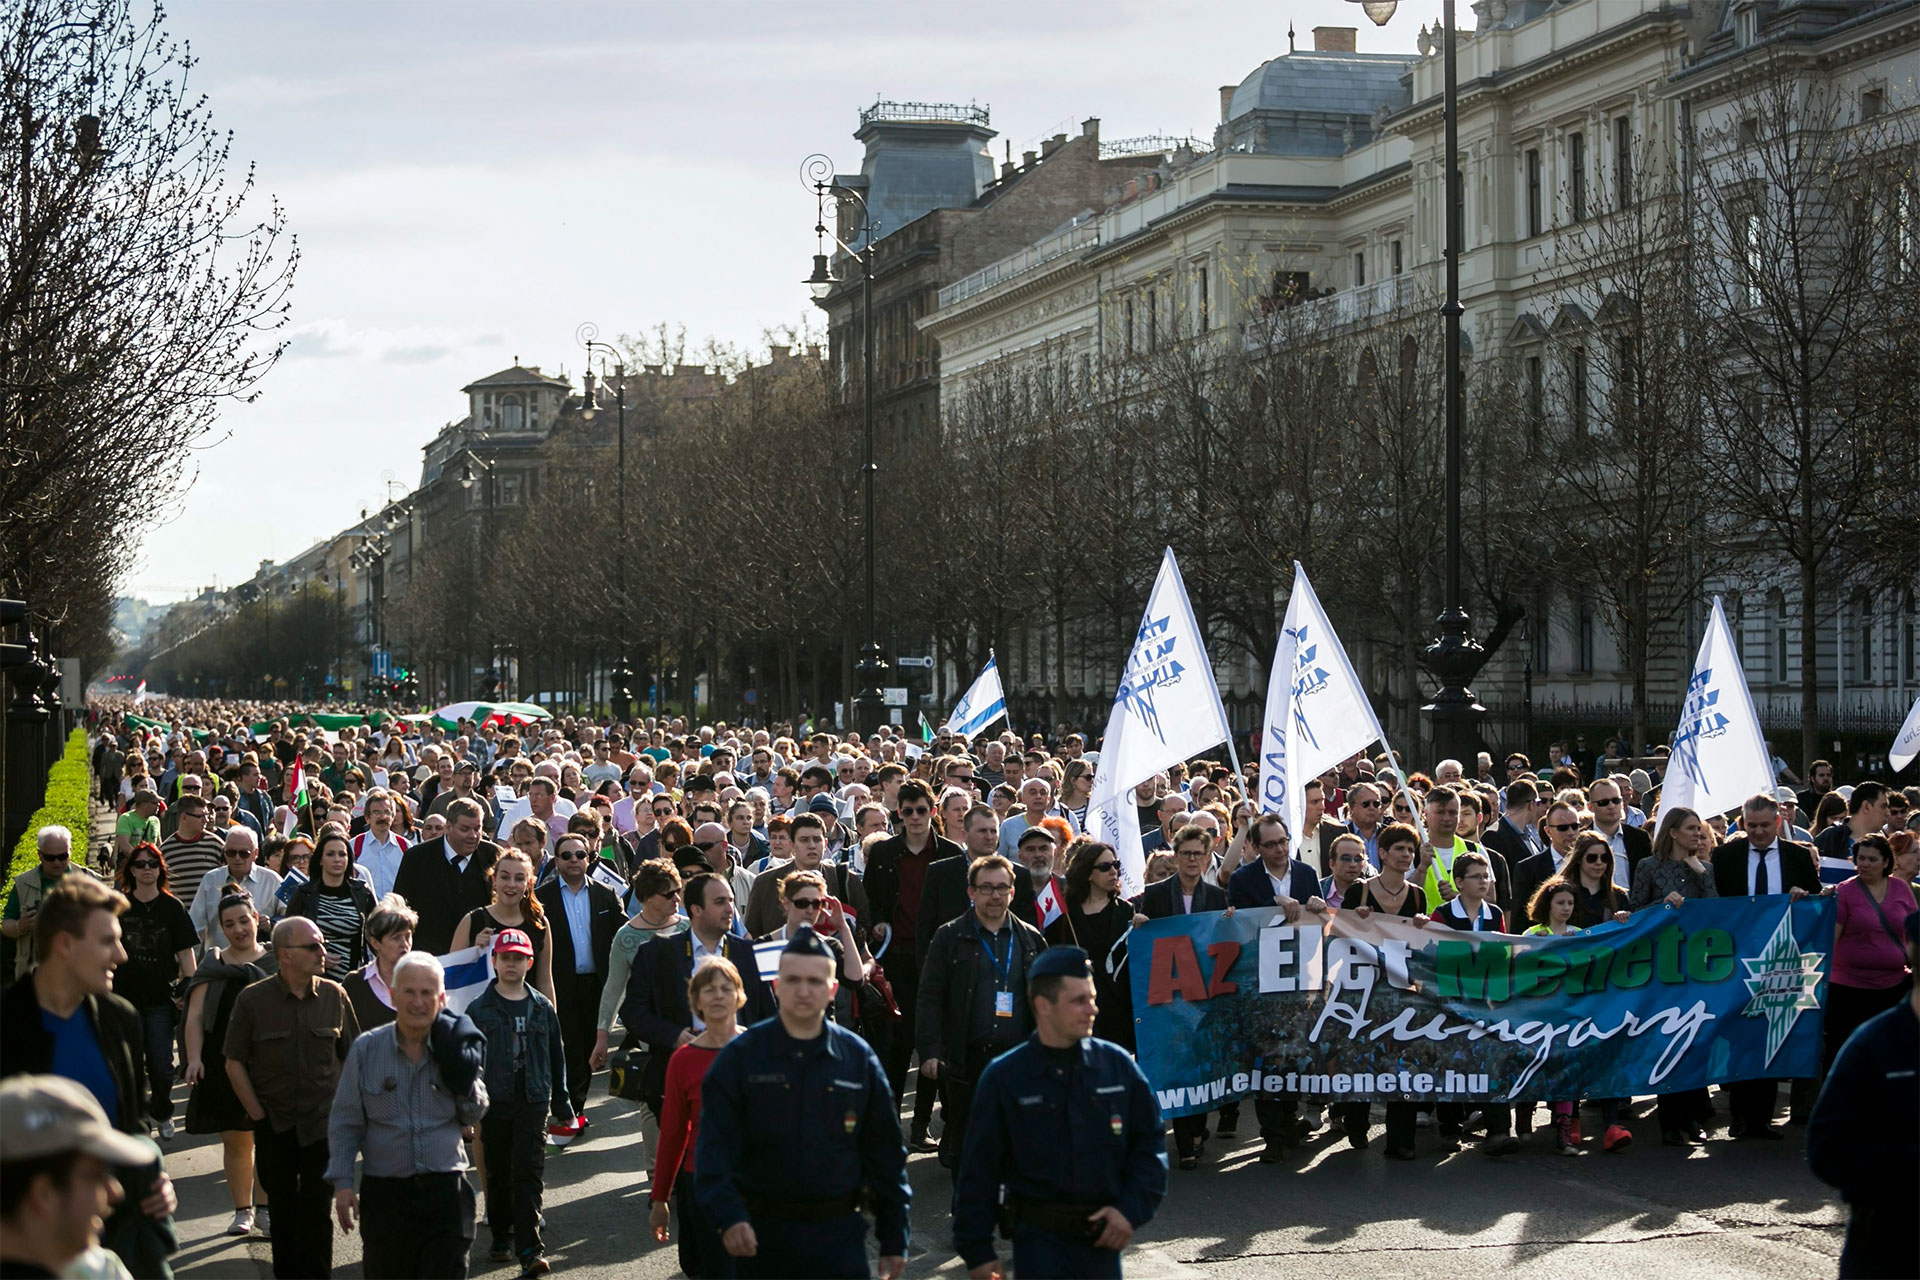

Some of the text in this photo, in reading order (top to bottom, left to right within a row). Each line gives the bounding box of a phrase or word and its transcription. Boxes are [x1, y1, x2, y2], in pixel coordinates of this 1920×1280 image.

[1148, 914, 1735, 1005] Az Élet Menete
[1309, 966, 1716, 1100] Hungary
[1156, 1069, 1489, 1110] www.eletmenete.hu
